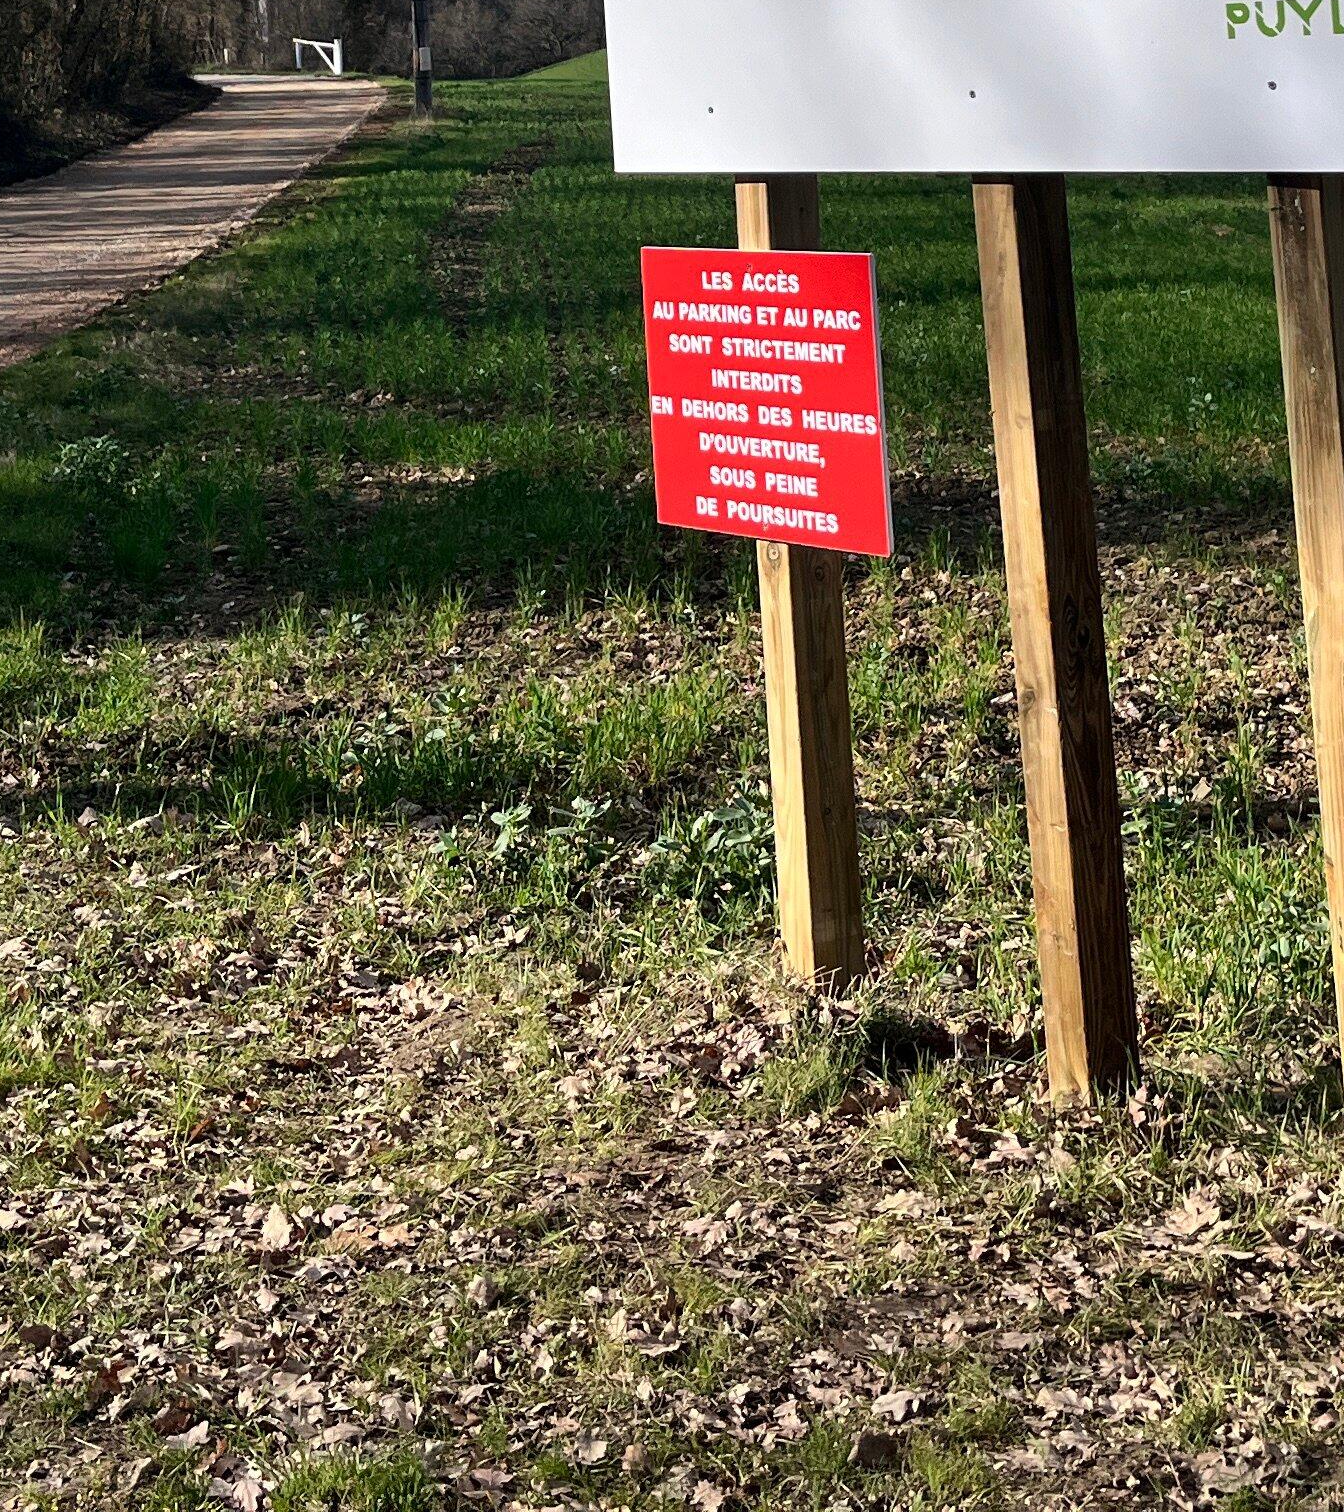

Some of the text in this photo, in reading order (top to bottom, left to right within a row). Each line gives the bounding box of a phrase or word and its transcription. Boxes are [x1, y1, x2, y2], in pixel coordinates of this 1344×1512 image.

[701, 270, 800, 294] LES ACCÈS
[652, 301, 862, 331] AU PARKING ET AU PARC
[668, 334, 846, 364] SONT STRICTEMENT
[711, 368, 803, 395] INTERDITS
[651, 395, 878, 436] EN DEHORS DES HEURES
[699, 432, 826, 468] D'OUVERTURE,
[709, 465, 818, 498] SOUS PEINE
[695, 495, 840, 534] DE POURSUITES
